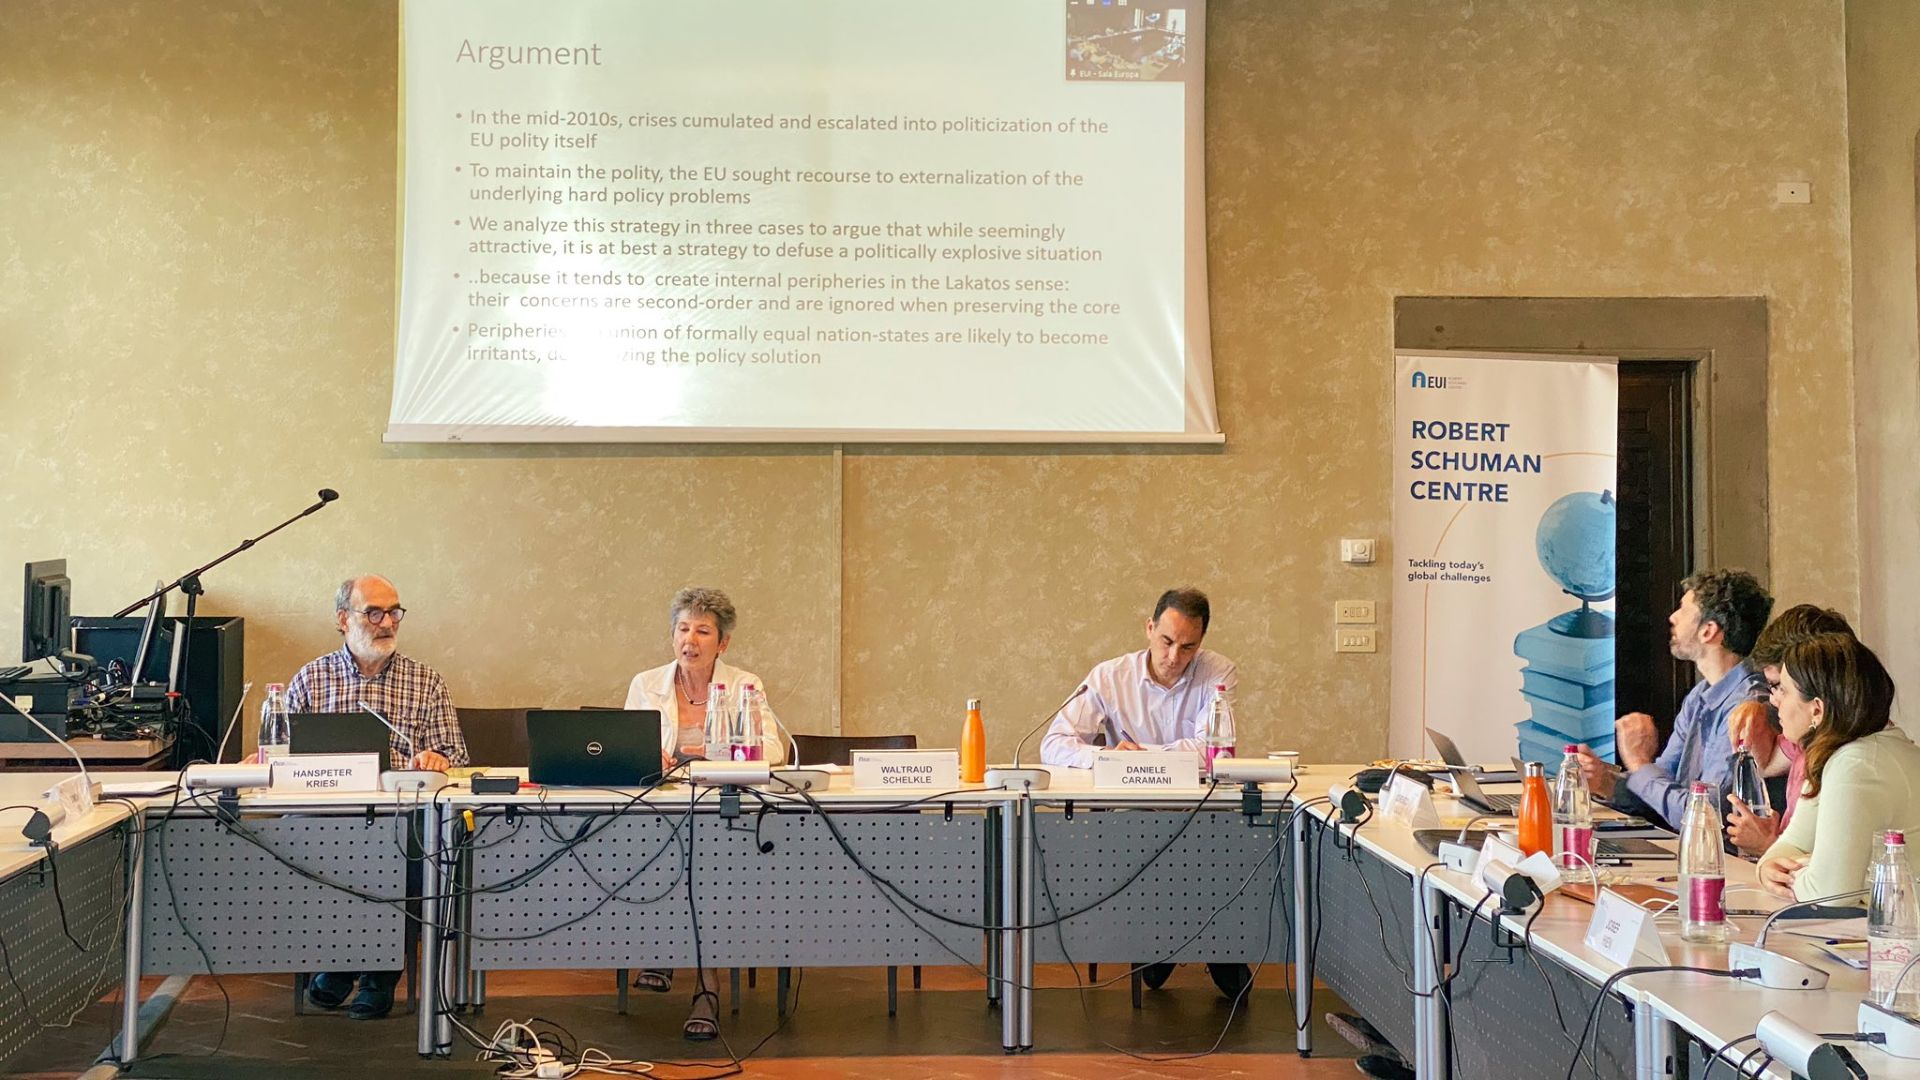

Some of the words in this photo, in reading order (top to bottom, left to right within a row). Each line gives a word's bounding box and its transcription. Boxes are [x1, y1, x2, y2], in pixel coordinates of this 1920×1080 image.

[456, 39, 602, 70] Argument
[471, 110, 486, 124] In
[491, 109, 521, 125] the
[525, 110, 623, 128] mid-2010s,
[629, 112, 677, 127] crises
[682, 113, 773, 128] cumulated
[780, 114, 811, 129] and
[817, 115, 897, 130] escalated
[904, 116, 937, 131] into
[943, 116, 1052, 134] politicization
[1058, 117, 1076, 133] of
[1080, 118, 1108, 133] the
[471, 132, 493, 147] EU
[500, 132, 549, 151] polity
[555, 133, 598, 149] itself
[469, 163, 489, 177] To
[496, 164, 571, 180] maintain
[577, 164, 606, 179] the
[612, 165, 663, 184] polity,
[669, 165, 698, 180] the
[704, 167, 726, 181] EU
[732, 166, 791, 185] sought
[797, 171, 871, 183] recourse
[876, 170, 894, 183] to
[899, 169, 1027, 185] externalization
[1032, 170, 1051, 185] of
[1054, 170, 1083, 186] the
[470, 185, 563, 205] underlying
[569, 186, 607, 202] hard
[614, 187, 664, 206] policy
[670, 188, 750, 206] problems
[469, 216, 498, 231] We
[503, 216, 568, 235] analyze
[573, 217, 605, 232] this
[610, 220, 680, 237] strategy
[686, 219, 700, 234] in
[706, 219, 752, 234] three
[758, 224, 804, 235] cases
[809, 222, 827, 236] to
[832, 225, 881, 239] argue
[886, 221, 922, 237] that
[927, 222, 973, 237] while
[978, 223, 1065, 242] seemingly
[469, 239, 556, 256] attractive,
[564, 240, 575, 254] it
[581, 240, 592, 254] is
[599, 242, 615, 254] at
[621, 240, 657, 256] best
[663, 245, 672, 256] a
[678, 243, 748, 260] strategy
[753, 244, 770, 257] to
[776, 241, 833, 257] defuse
[839, 247, 848, 258] a
[855, 243, 937, 262] politically
[942, 244, 1021, 263] explosive
[1026, 246, 1102, 261] situation
[469, 268, 551, 285] ..because
[557, 271, 568, 284] it
[574, 270, 621, 285] tends
[627, 273, 644, 285] to
[655, 274, 712, 287] create
[714, 272, 781, 288] internal
[788, 273, 885, 292] peripheries
[891, 275, 906, 290] in
[911, 274, 940, 290] the
[946, 275, 1010, 291] Lakatos
[1015, 280, 1069, 291] sense:
[468, 291, 510, 307] their
[520, 291, 598, 307] concerns
[604, 297, 632, 308] are
[637, 292, 753, 310] second-order
[758, 295, 790, 310] and
[796, 300, 823, 311] are
[829, 296, 895, 314] ignored
[900, 296, 947, 312] when
[954, 299, 1044, 317] preserving
[1049, 298, 1077, 314] the
[1083, 303, 1120, 314] core
[664, 325, 682, 340] of
[686, 324, 758, 345] formally
[763, 326, 810, 344] equal
[817, 327, 929, 342] nation-states
[934, 332, 962, 343] are
[968, 328, 1011, 347] likely
[1016, 331, 1034, 344] to
[1040, 328, 1108, 344] become
[468, 344, 541, 364] irritants,
[661, 347, 689, 365] the
[696, 347, 746, 367] policy
[750, 348, 821, 364] solution
[1428, 376, 1446, 389] EUI
[1412, 420, 1510, 442] ROBERT
[1411, 451, 1541, 473] SCHUMAN
[1410, 481, 1509, 502] CENTRE
[1408, 559, 1446, 570] Tackling
[1449, 560, 1484, 571] today's
[1408, 572, 1437, 582] global
[1440, 573, 1491, 583] challenges
[293, 768, 352, 778] HANSPETER
[881, 766, 933, 774] WALTRAUD
[882, 776, 932, 784] SCHELKLE
[1121, 776, 1172, 785] CARAMANI
[1126, 766, 1166, 774] DANIELE
[306, 779, 338, 788] KRIESI
